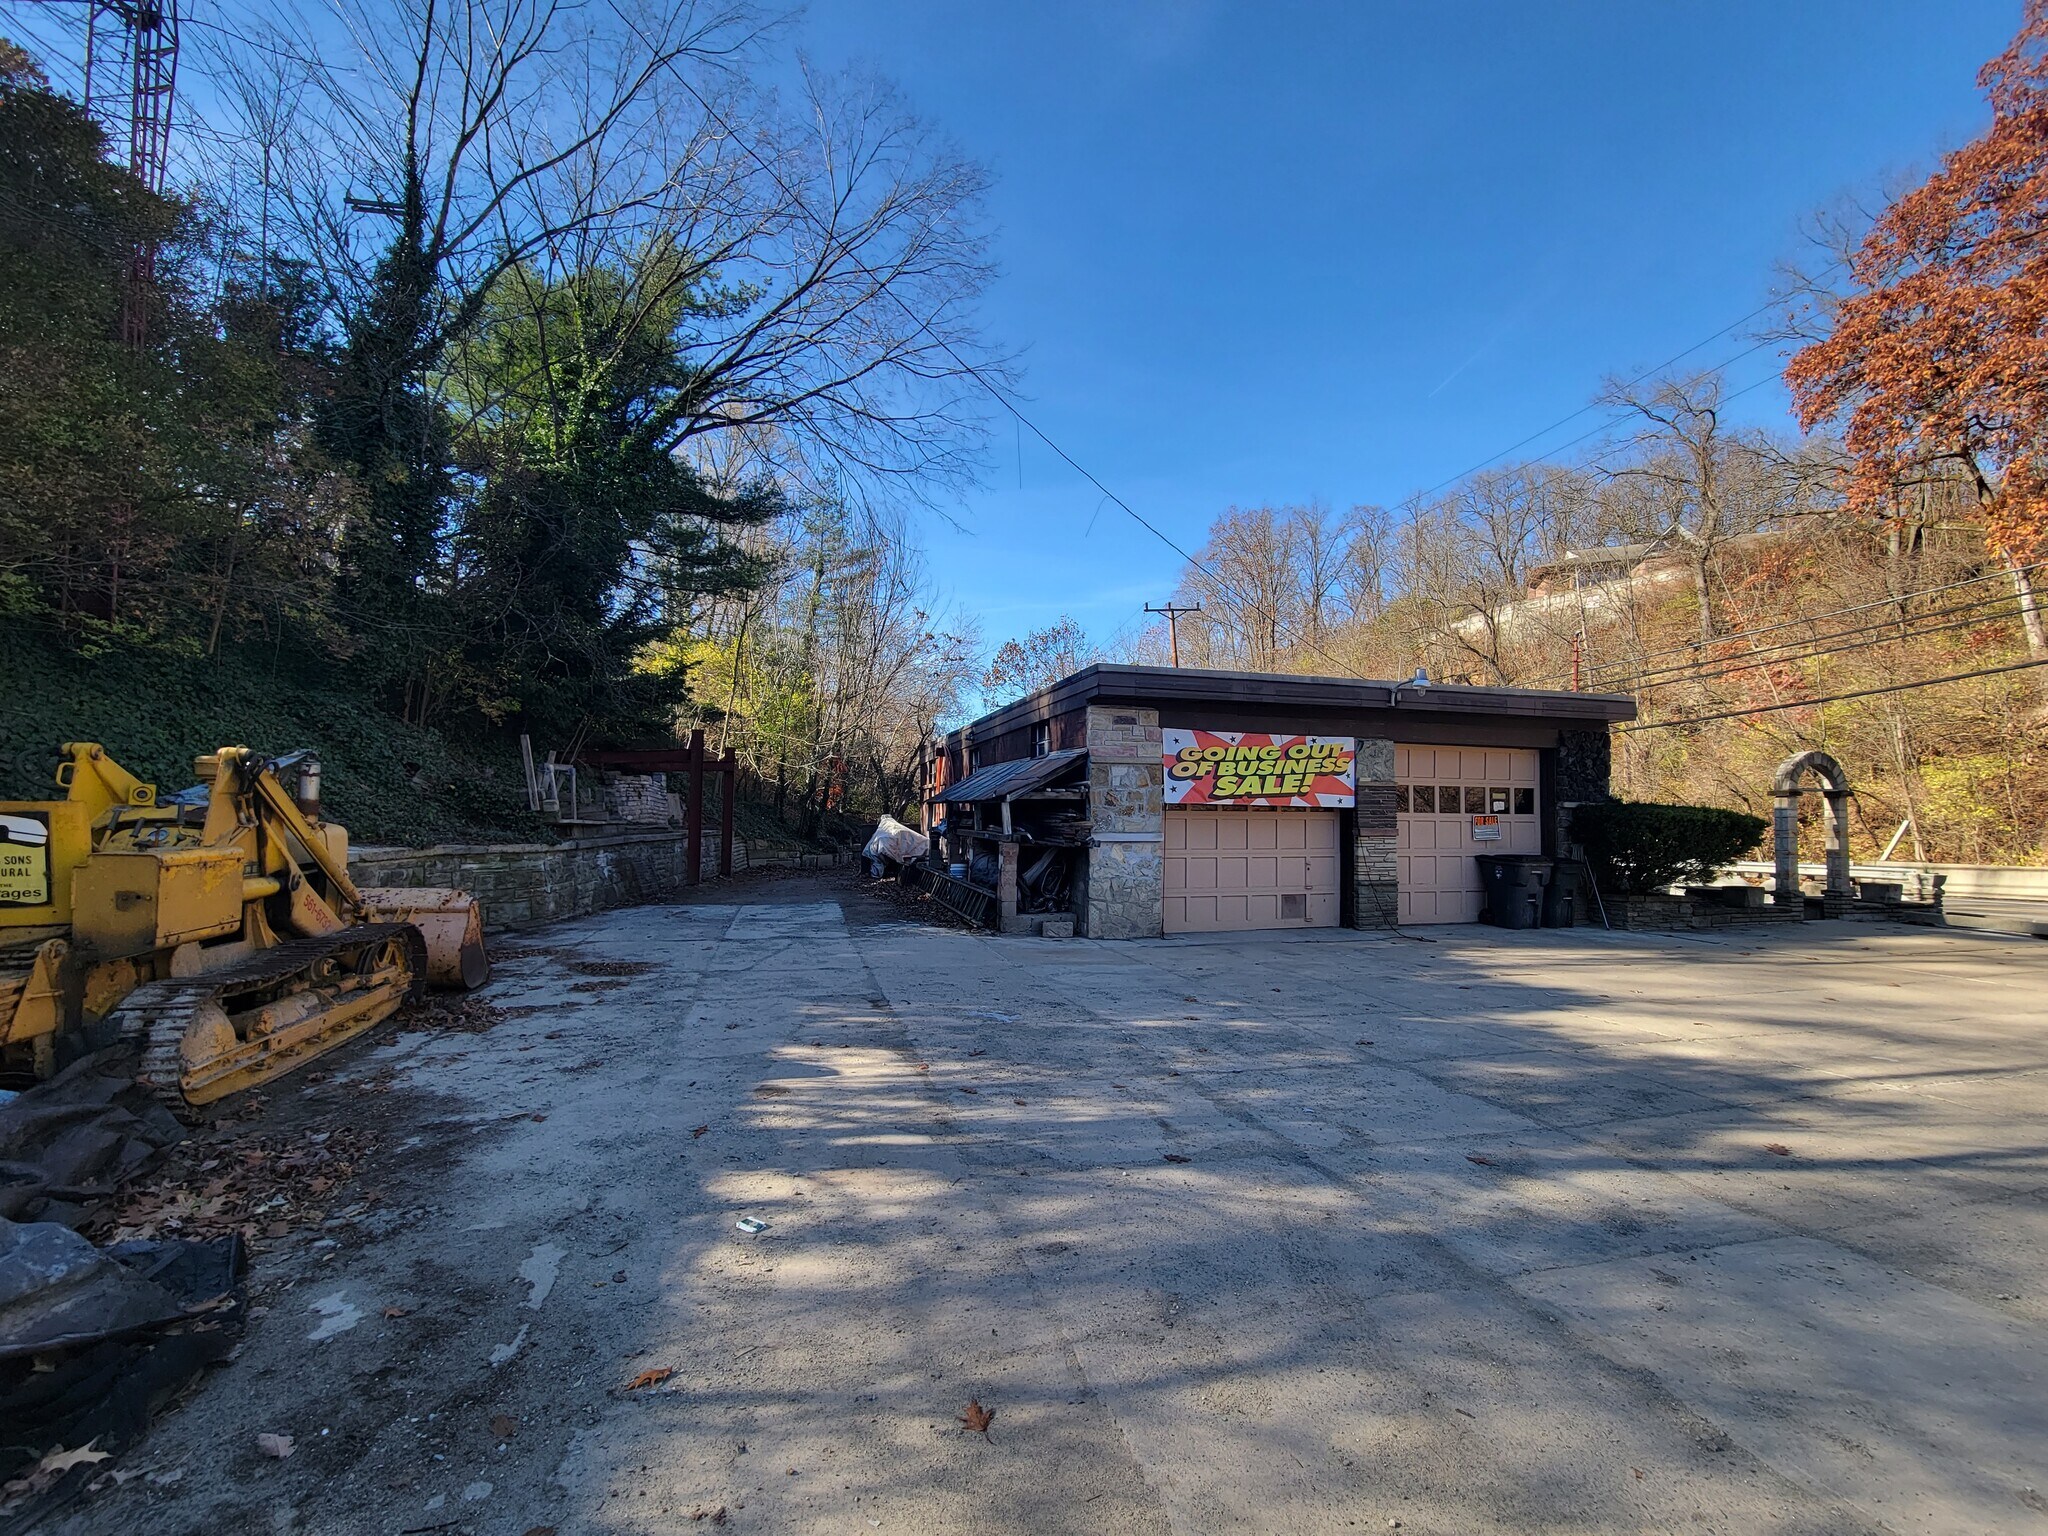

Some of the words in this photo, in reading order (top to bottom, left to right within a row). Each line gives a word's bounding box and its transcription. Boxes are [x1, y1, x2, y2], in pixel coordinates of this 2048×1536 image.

[1178, 745, 1282, 762] GOING
[1287, 742, 1345, 760] OUT
[1168, 761, 1218, 779] OF
[1217, 757, 1351, 777] BUSINESS
[1209, 773, 1315, 797] SALE!
[1486, 816, 1498, 825] SALE
[4, 855, 32, 865] SONS
